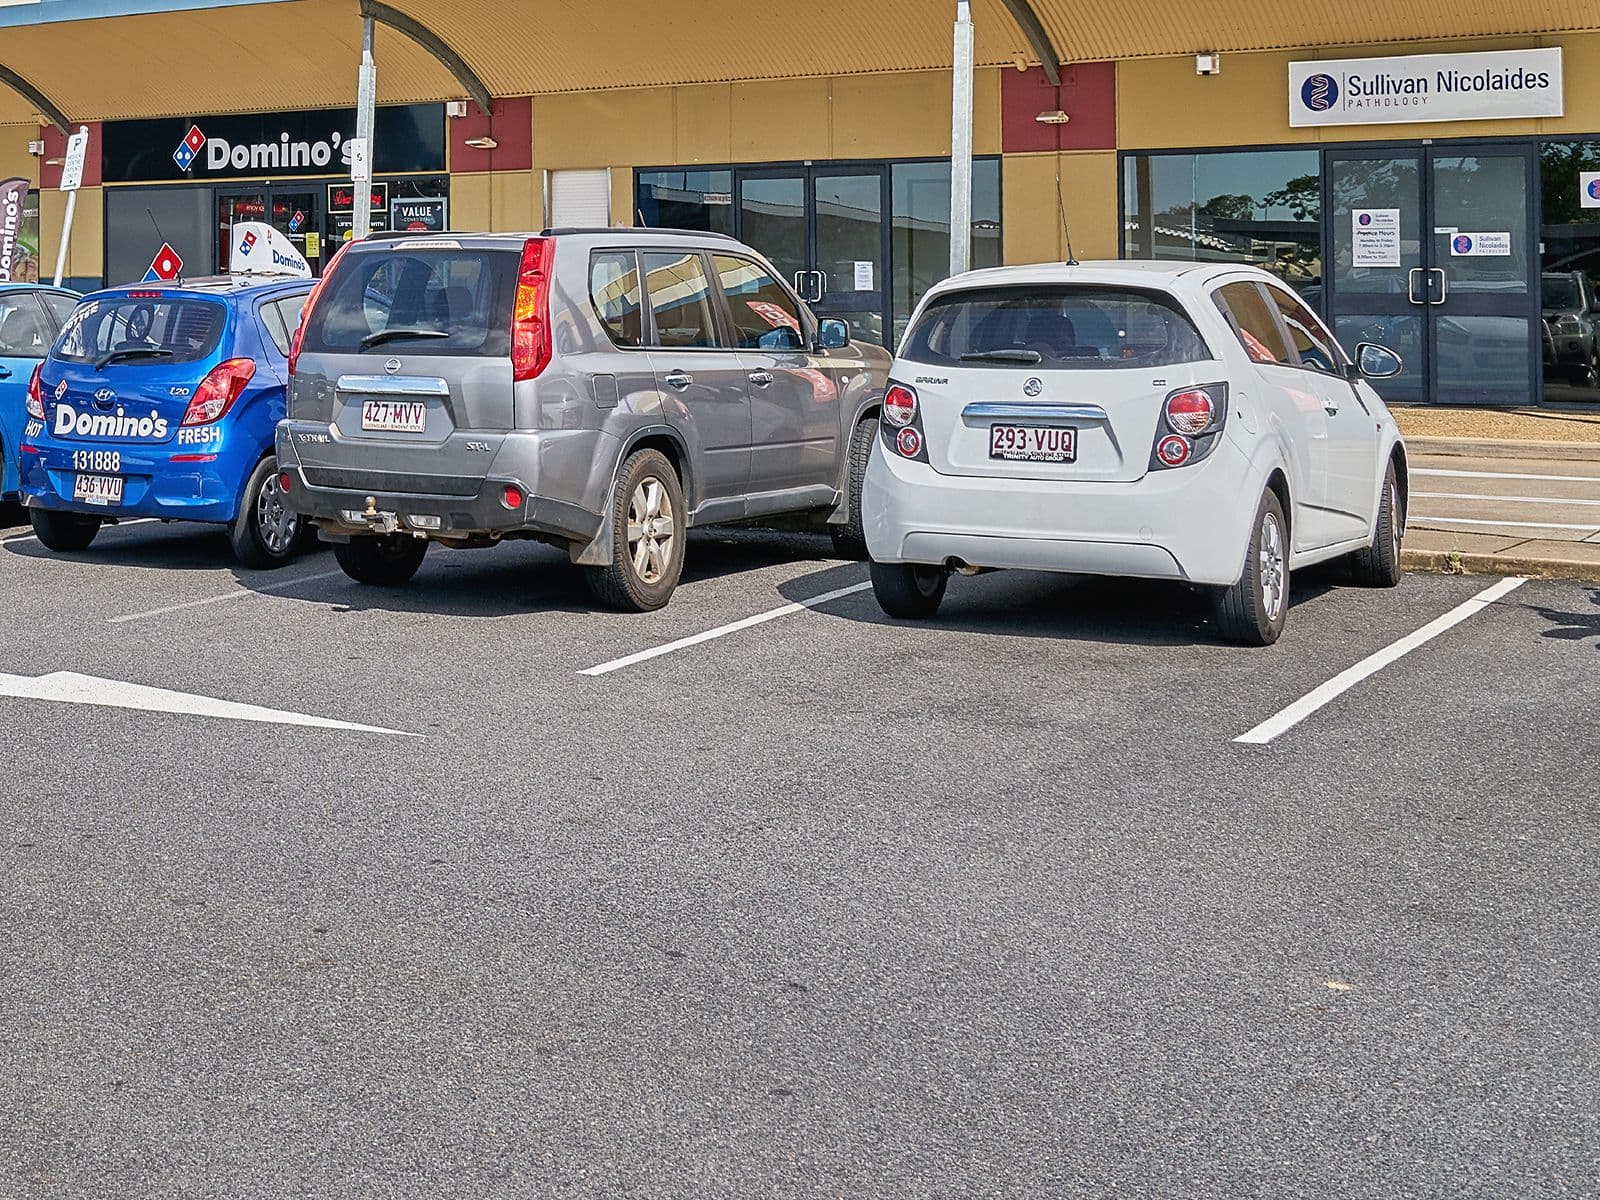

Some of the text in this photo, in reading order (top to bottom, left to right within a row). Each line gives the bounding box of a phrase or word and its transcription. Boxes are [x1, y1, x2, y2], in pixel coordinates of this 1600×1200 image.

[1348, 68, 1550, 97] Sullivan Nicolaides
[1348, 97, 1429, 109] PATHOLOGY
[73, 138, 82, 151] P
[207, 132, 352, 170] Domino's
[401, 206, 432, 217] VALUE
[272, 249, 306, 270] Domino's
[24, 420, 43, 438] HOT
[54, 404, 168, 438] Domino's
[178, 427, 220, 444] FRESH
[72, 450, 121, 472] 131888
